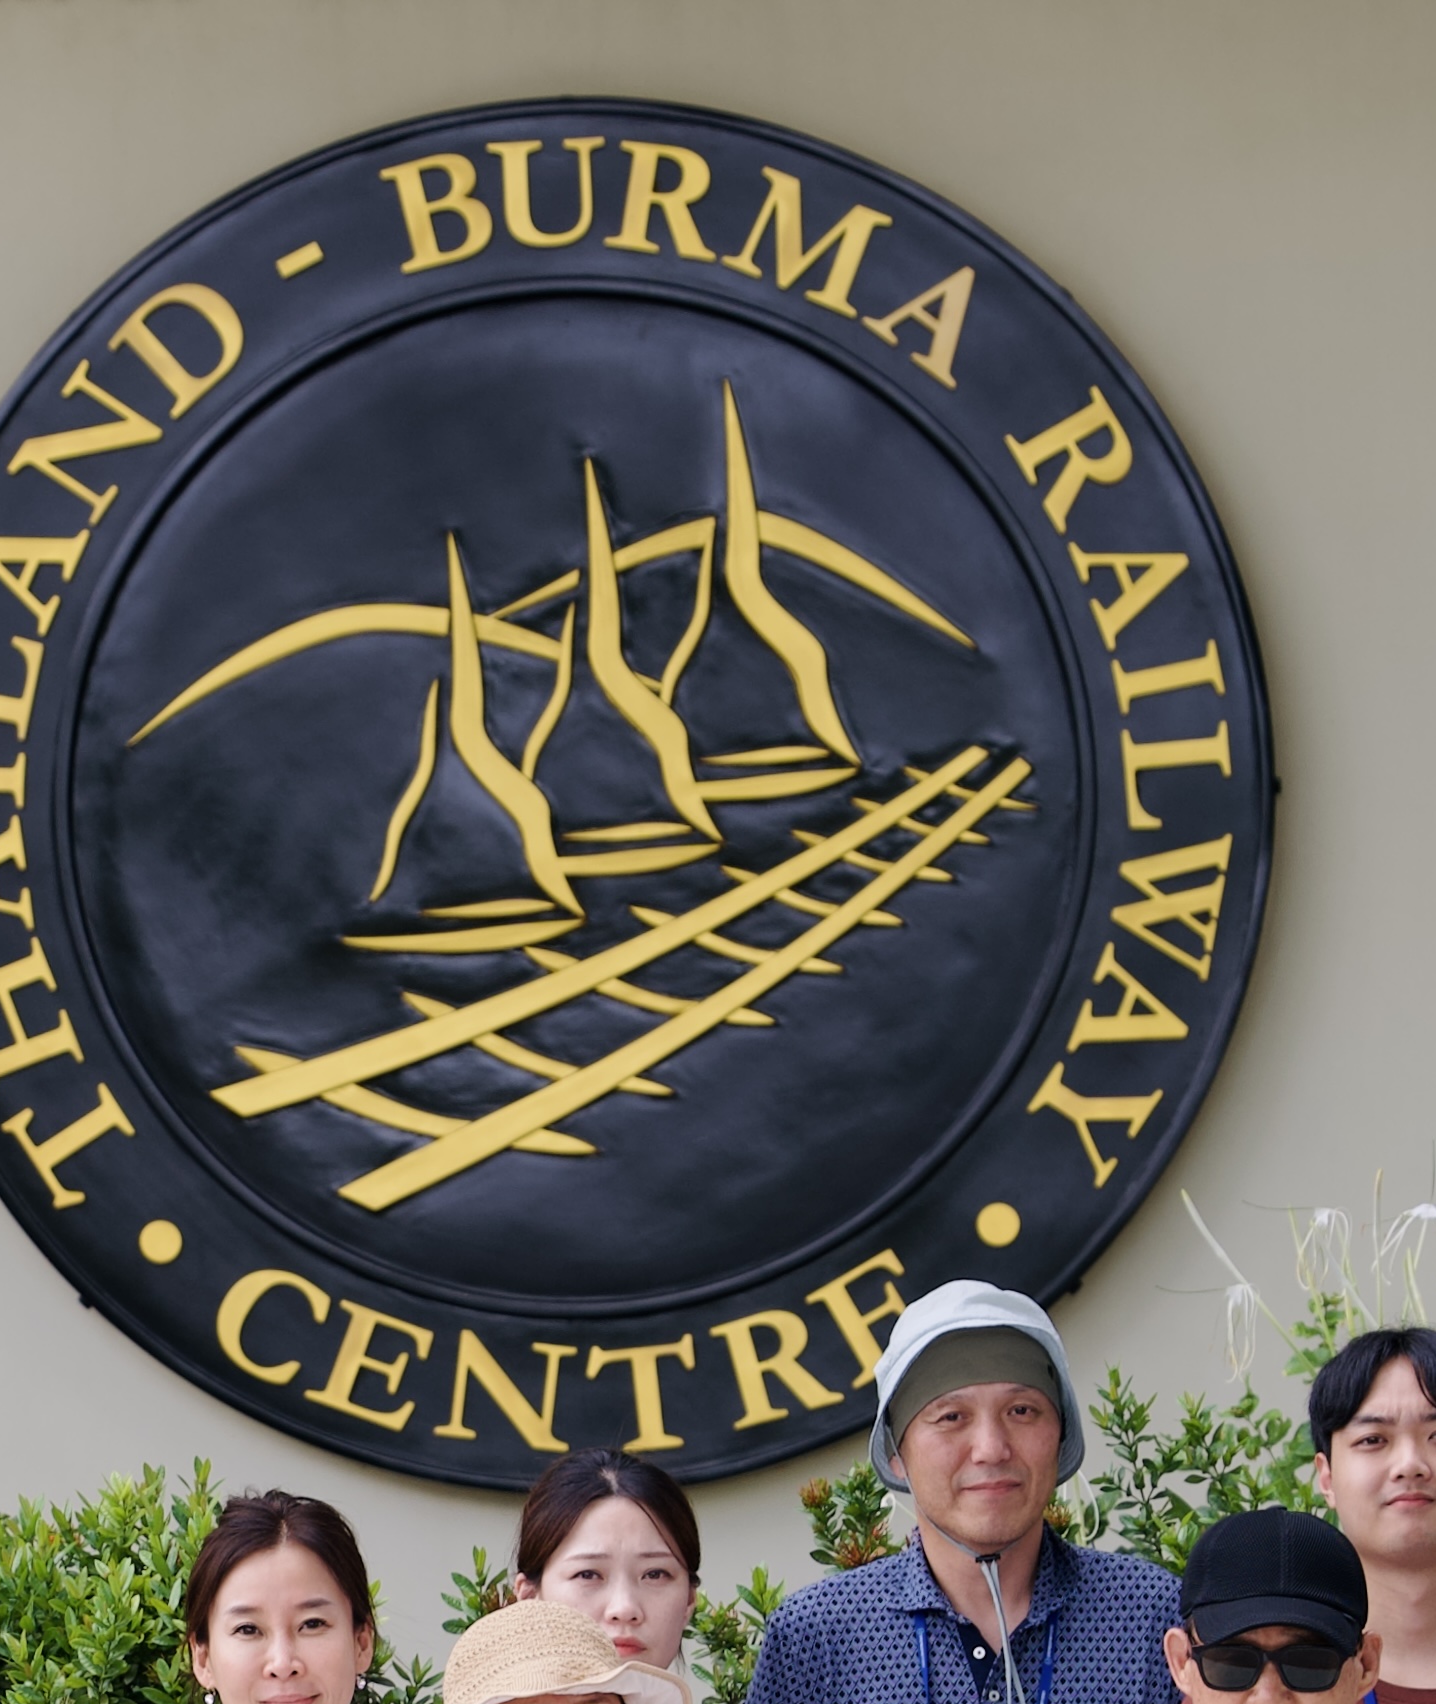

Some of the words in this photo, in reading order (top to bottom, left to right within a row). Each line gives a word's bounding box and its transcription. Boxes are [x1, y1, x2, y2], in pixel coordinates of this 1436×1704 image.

[379, 137, 976, 389] BURMA
[1004, 386, 1234, 1188] RAILWAY
[215, 1247, 906, 1453] CENTRE
